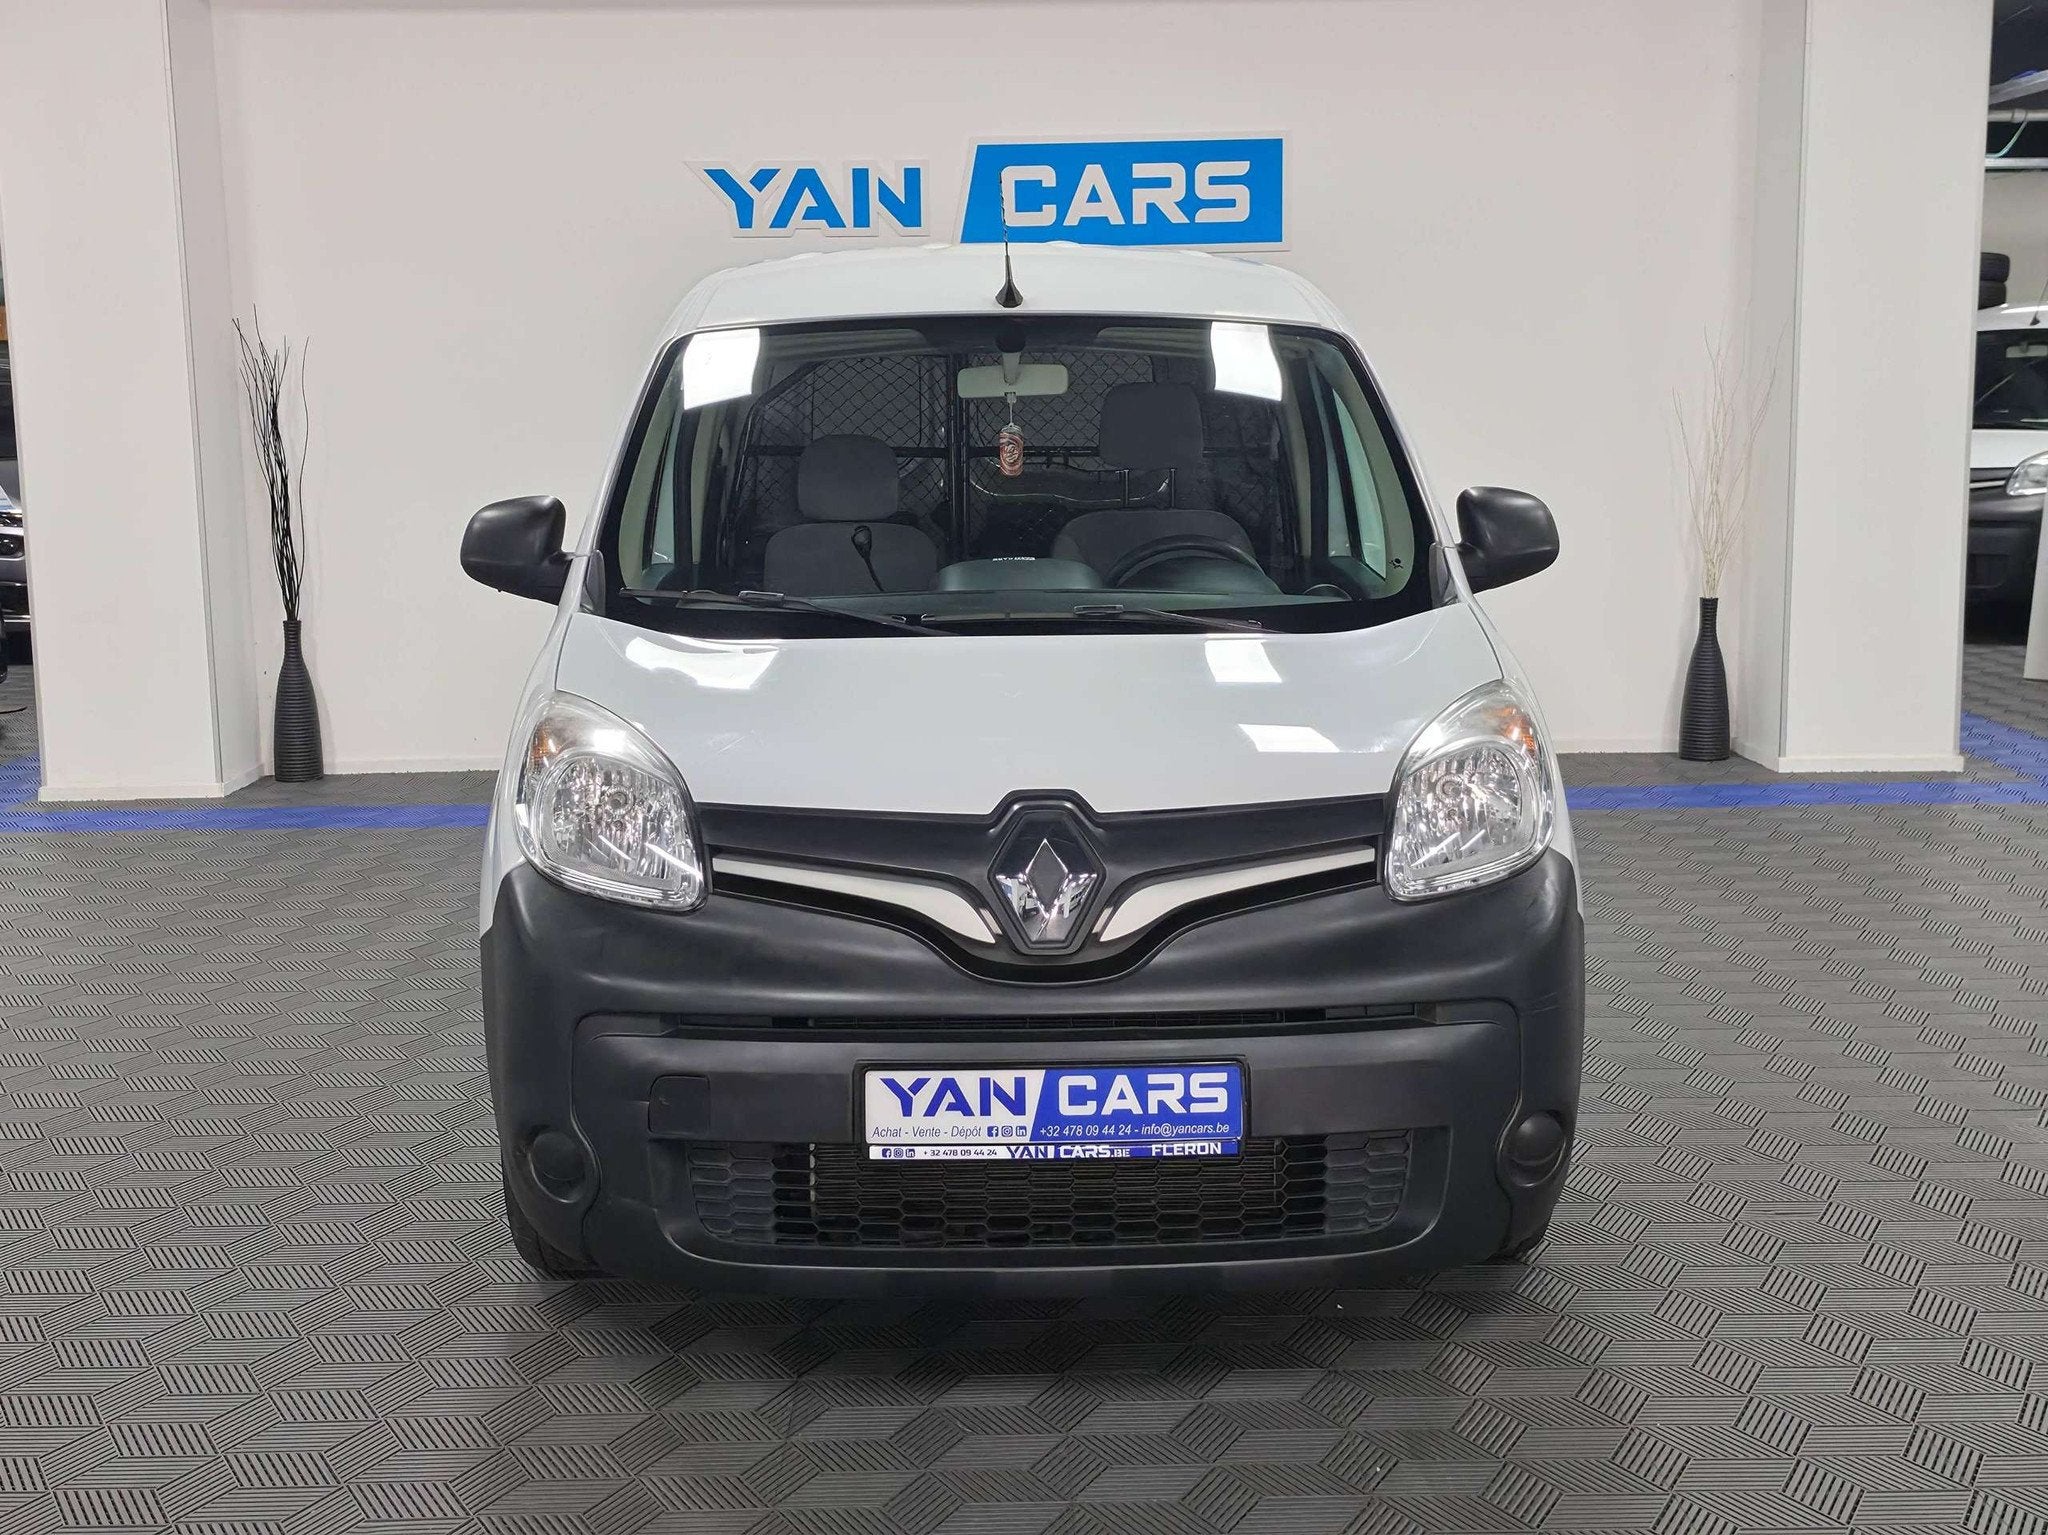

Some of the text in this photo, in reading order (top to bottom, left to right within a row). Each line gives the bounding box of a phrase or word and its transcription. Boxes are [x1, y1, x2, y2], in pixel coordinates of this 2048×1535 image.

[703, 161, 1250, 229] YAN CARS
[880, 1072, 1228, 1117] YAN CARS
[871, 1127, 902, 1138] Achat
[911, 1126, 941, 1137] Vente
[951, 1125, 982, 1139] Dépôt
[1040, 1126, 1060, 1137] +32
[1063, 1126, 1083, 1136] 478
[1085, 1125, 1099, 1135] 09
[1102, 1125, 1115, 1135] 44
[1118, 1124, 1132, 1135] 24
[1141, 1123, 1230, 1138] info@yancars.be
[943, 1149, 957, 1157] 478
[1006, 1146, 1049, 1158] YAN
[1151, 1143, 1222, 1157] FLERON
